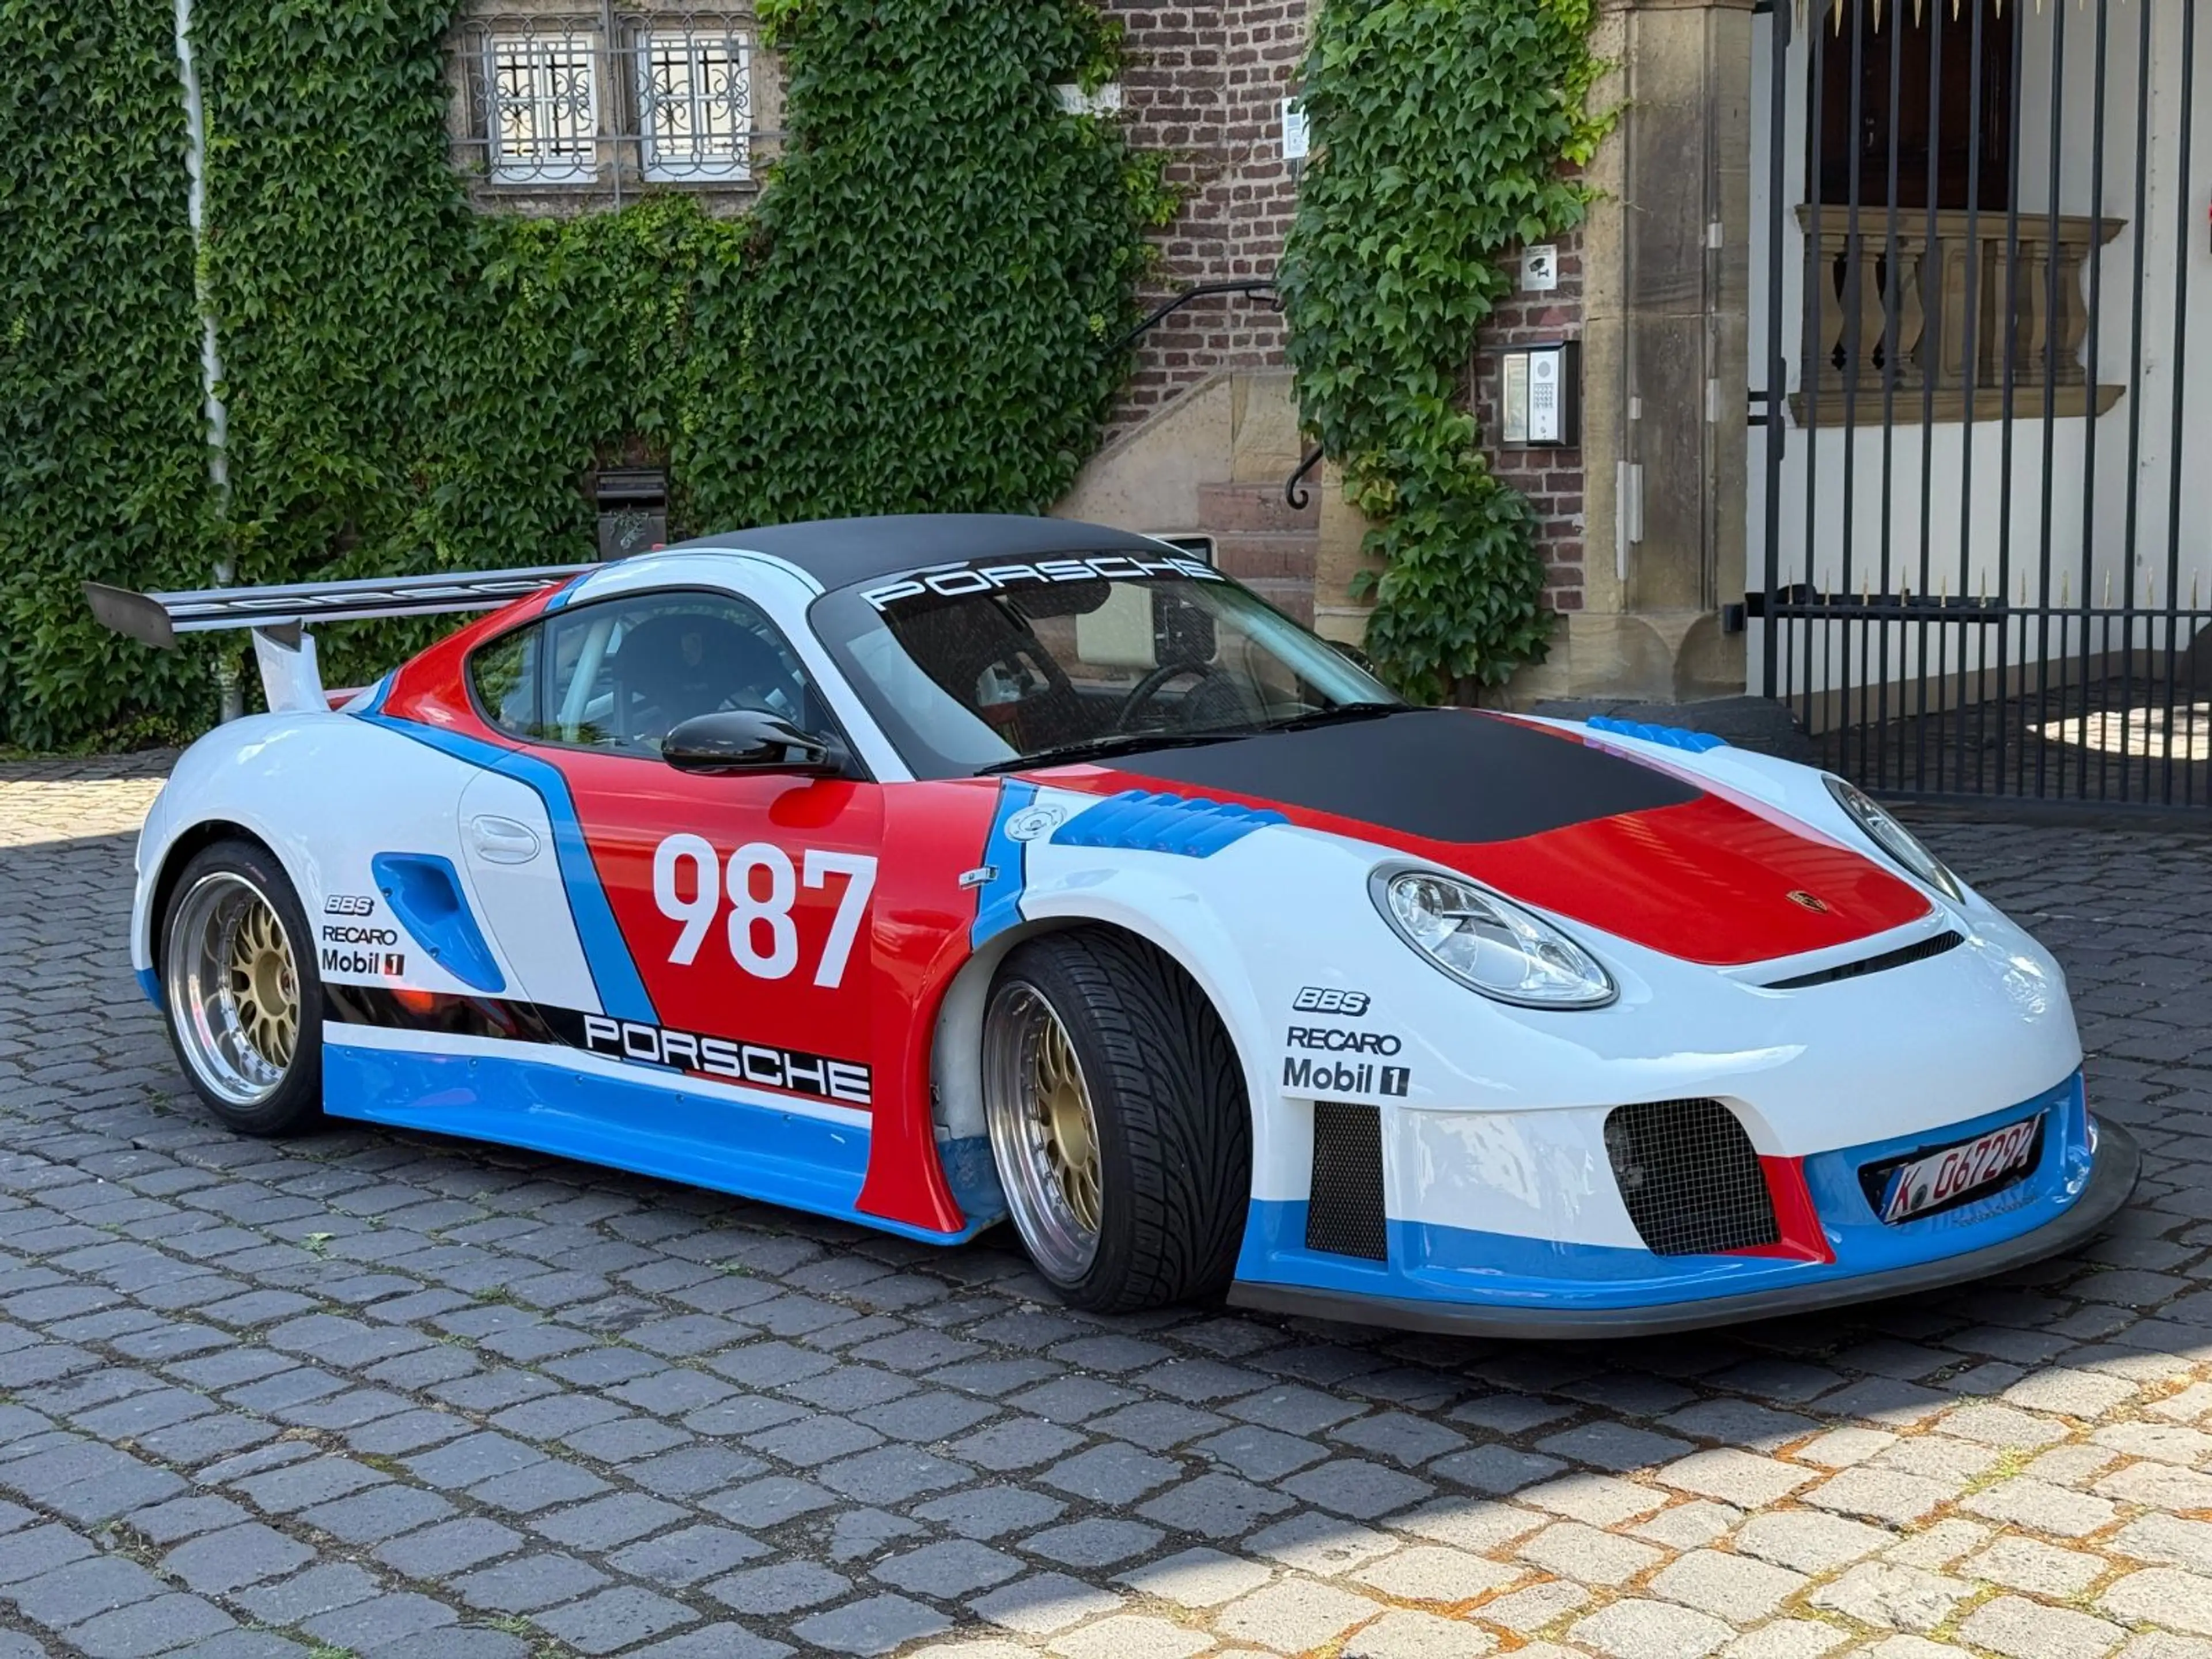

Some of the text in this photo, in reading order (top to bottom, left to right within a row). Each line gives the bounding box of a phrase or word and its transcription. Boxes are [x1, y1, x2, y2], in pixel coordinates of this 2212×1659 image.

[860, 557, 1225, 611] PORSCHE
[324, 895, 374, 916] BBS
[653, 833, 878, 989] 987
[323, 925, 397, 945] RECARO
[322, 948, 380, 974] Mobil
[1292, 987, 1371, 1017] BBS
[1287, 1026, 1402, 1056] RECARO
[584, 1014, 872, 1104] PORSCHE
[1283, 1056, 1373, 1093] Mobil
[1892, 1166, 1921, 1215] K
[1933, 1122, 2035, 1199] 067292
